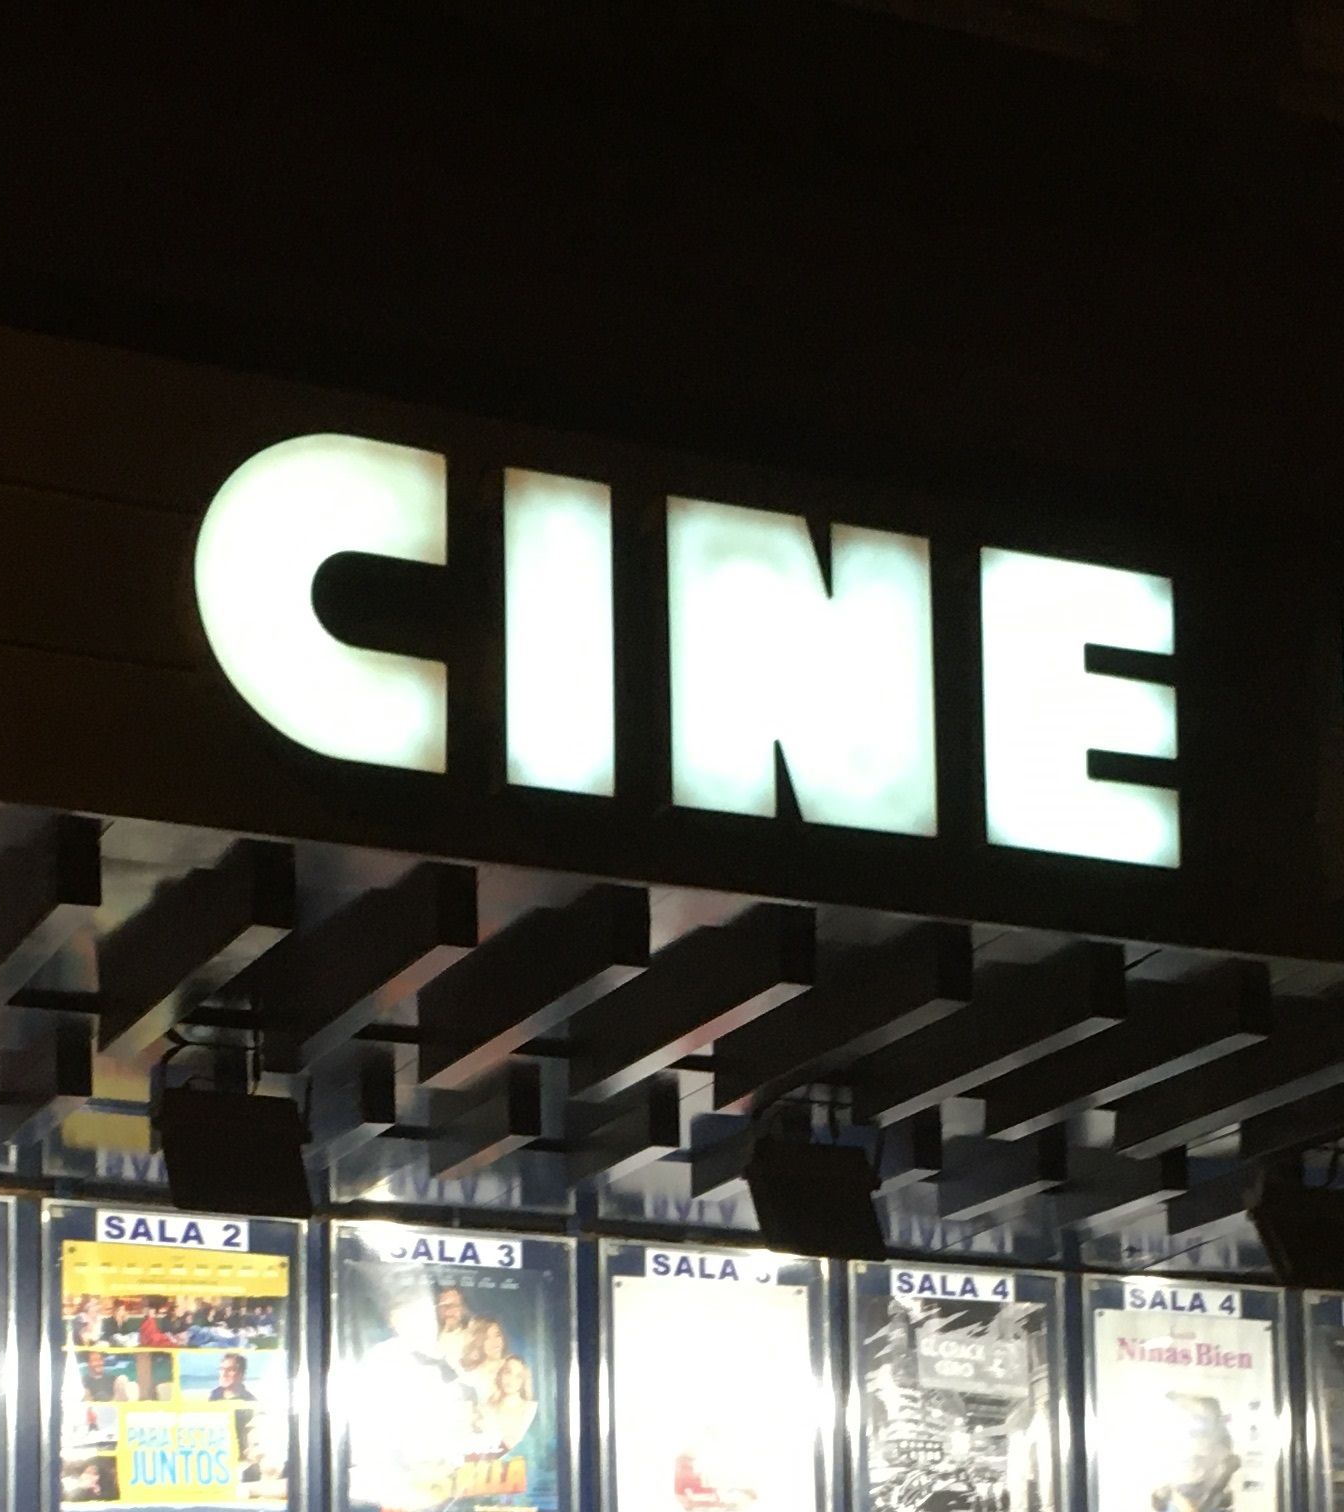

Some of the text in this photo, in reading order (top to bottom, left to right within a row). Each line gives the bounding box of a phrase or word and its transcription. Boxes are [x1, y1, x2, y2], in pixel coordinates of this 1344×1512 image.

[193, 429, 1183, 872] CINE
[104, 1215, 243, 1249] SALA 2
[497, 1244, 516, 1268] 3
[652, 1253, 739, 1282] SALA
[896, 1272, 1010, 1300] SALA 4
[1129, 1288, 1237, 1316] SALA 4
[1196, 1342, 1253, 1369] Bien
[129, 1449, 231, 1486] JUNTOS
